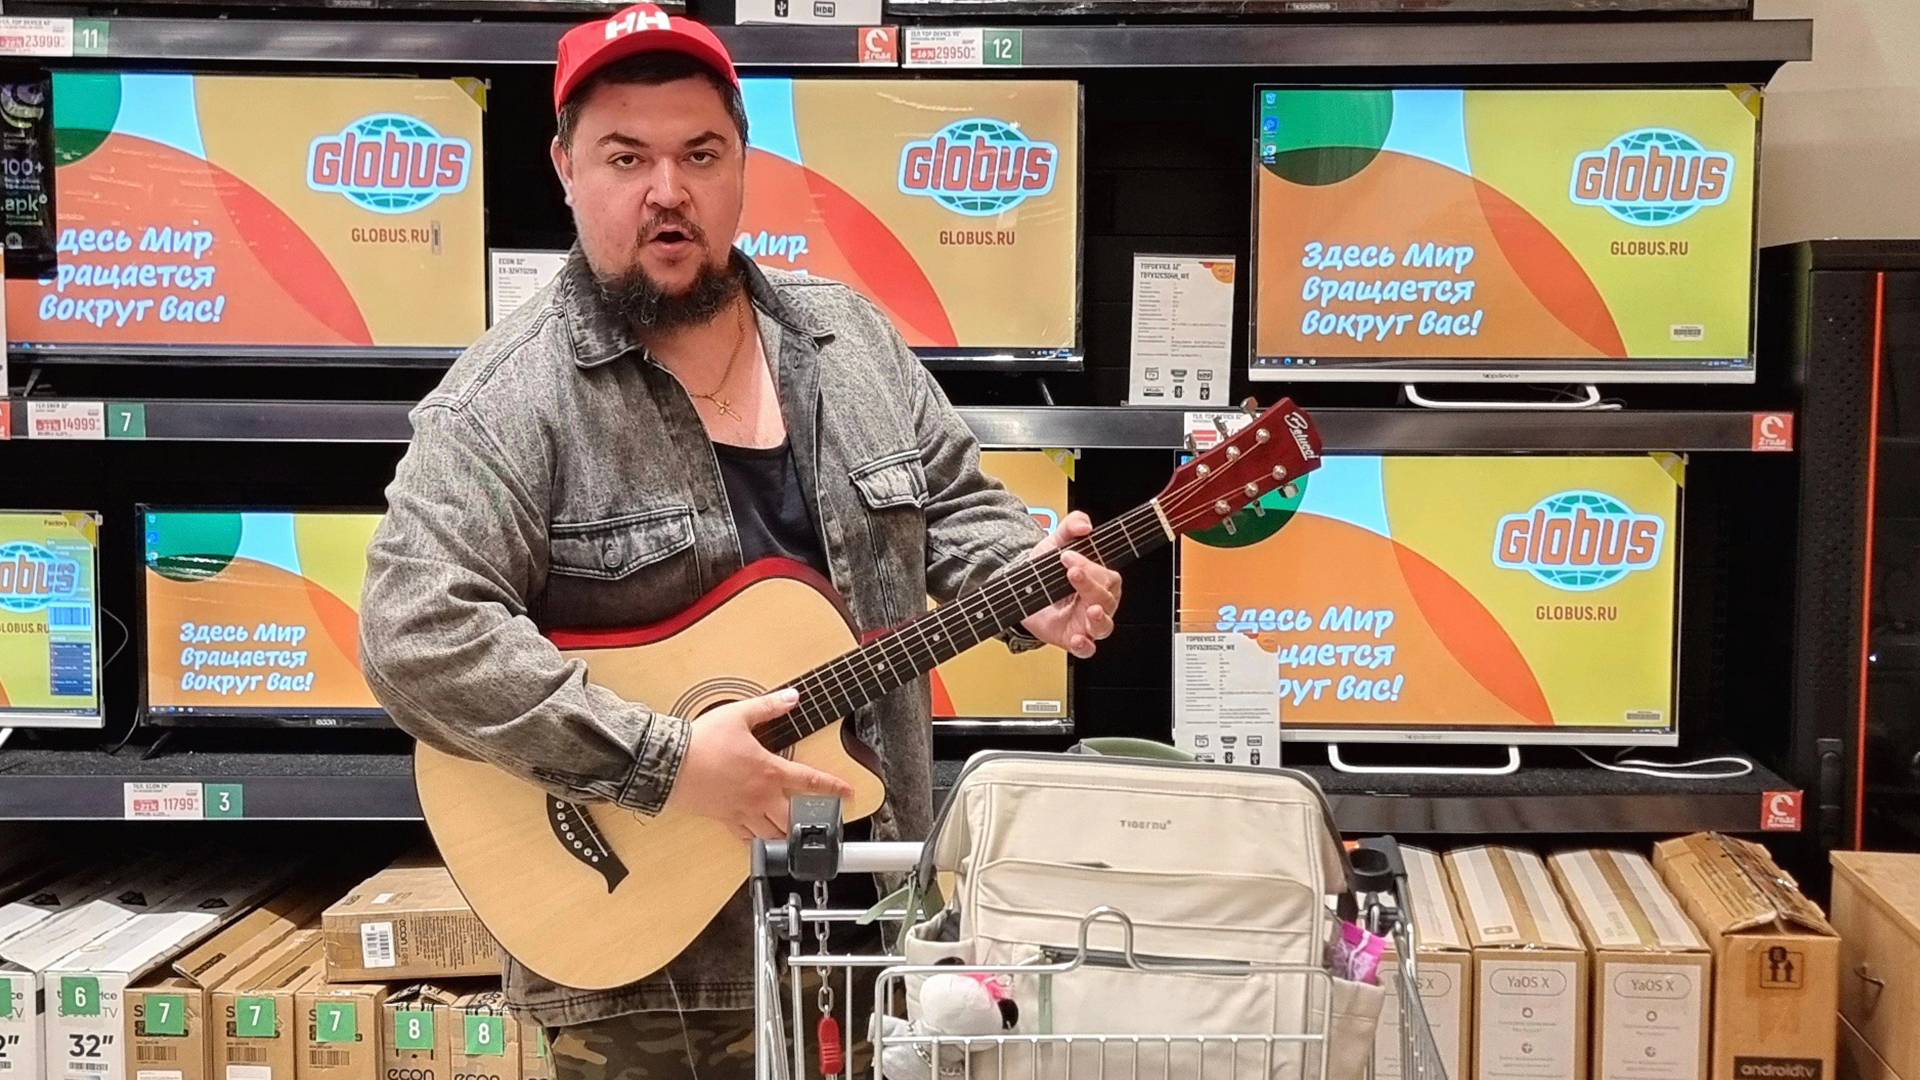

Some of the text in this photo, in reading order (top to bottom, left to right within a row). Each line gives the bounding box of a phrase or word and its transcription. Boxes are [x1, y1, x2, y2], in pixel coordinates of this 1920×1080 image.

[82, 28, 98, 48] 11
[993, 38, 1012, 58] 12
[936, 46, 971, 59] 29950
[57, 226, 213, 260] десь Мир
[351, 228, 430, 243] GLOBUS.RU
[733, 230, 809, 263] Мир
[939, 231, 1015, 245] GLOBUS.RU
[1301, 241, 1475, 274] Здесь Мир
[1610, 241, 1689, 255] GLOBUS.RU
[39, 264, 216, 292] ращается
[1301, 275, 1475, 308] вращается
[39, 294, 225, 328] вокруг вас!
[1301, 309, 1484, 342] вокруг вас!
[62, 418, 96, 431] 14999
[120, 412, 132, 432] 7
[1216, 604, 1395, 639] Здесь Мир
[1536, 606, 1617, 621] GLOBUS.RU
[0, 622, 50, 635] LOBUS.RU
[180, 622, 306, 647] Здесь Мир
[180, 647, 308, 671] вращается
[1279, 643, 1396, 669] щается
[181, 671, 315, 696] вокруг вас!
[1336, 674, 1405, 702] вас!
[163, 798, 194, 811] 11799
[219, 791, 231, 811] 3
[1507, 975, 1550, 989] YaOS X
[1631, 978, 1675, 992] YaOS X
[74, 986, 87, 1008] 6
[158, 1002, 170, 1024] 7
[249, 1005, 261, 1027] 7
[329, 1010, 341, 1032] 7
[408, 1018, 420, 1039] 8
[478, 1022, 490, 1044] 8
[68, 1033, 114, 1058] 32"
